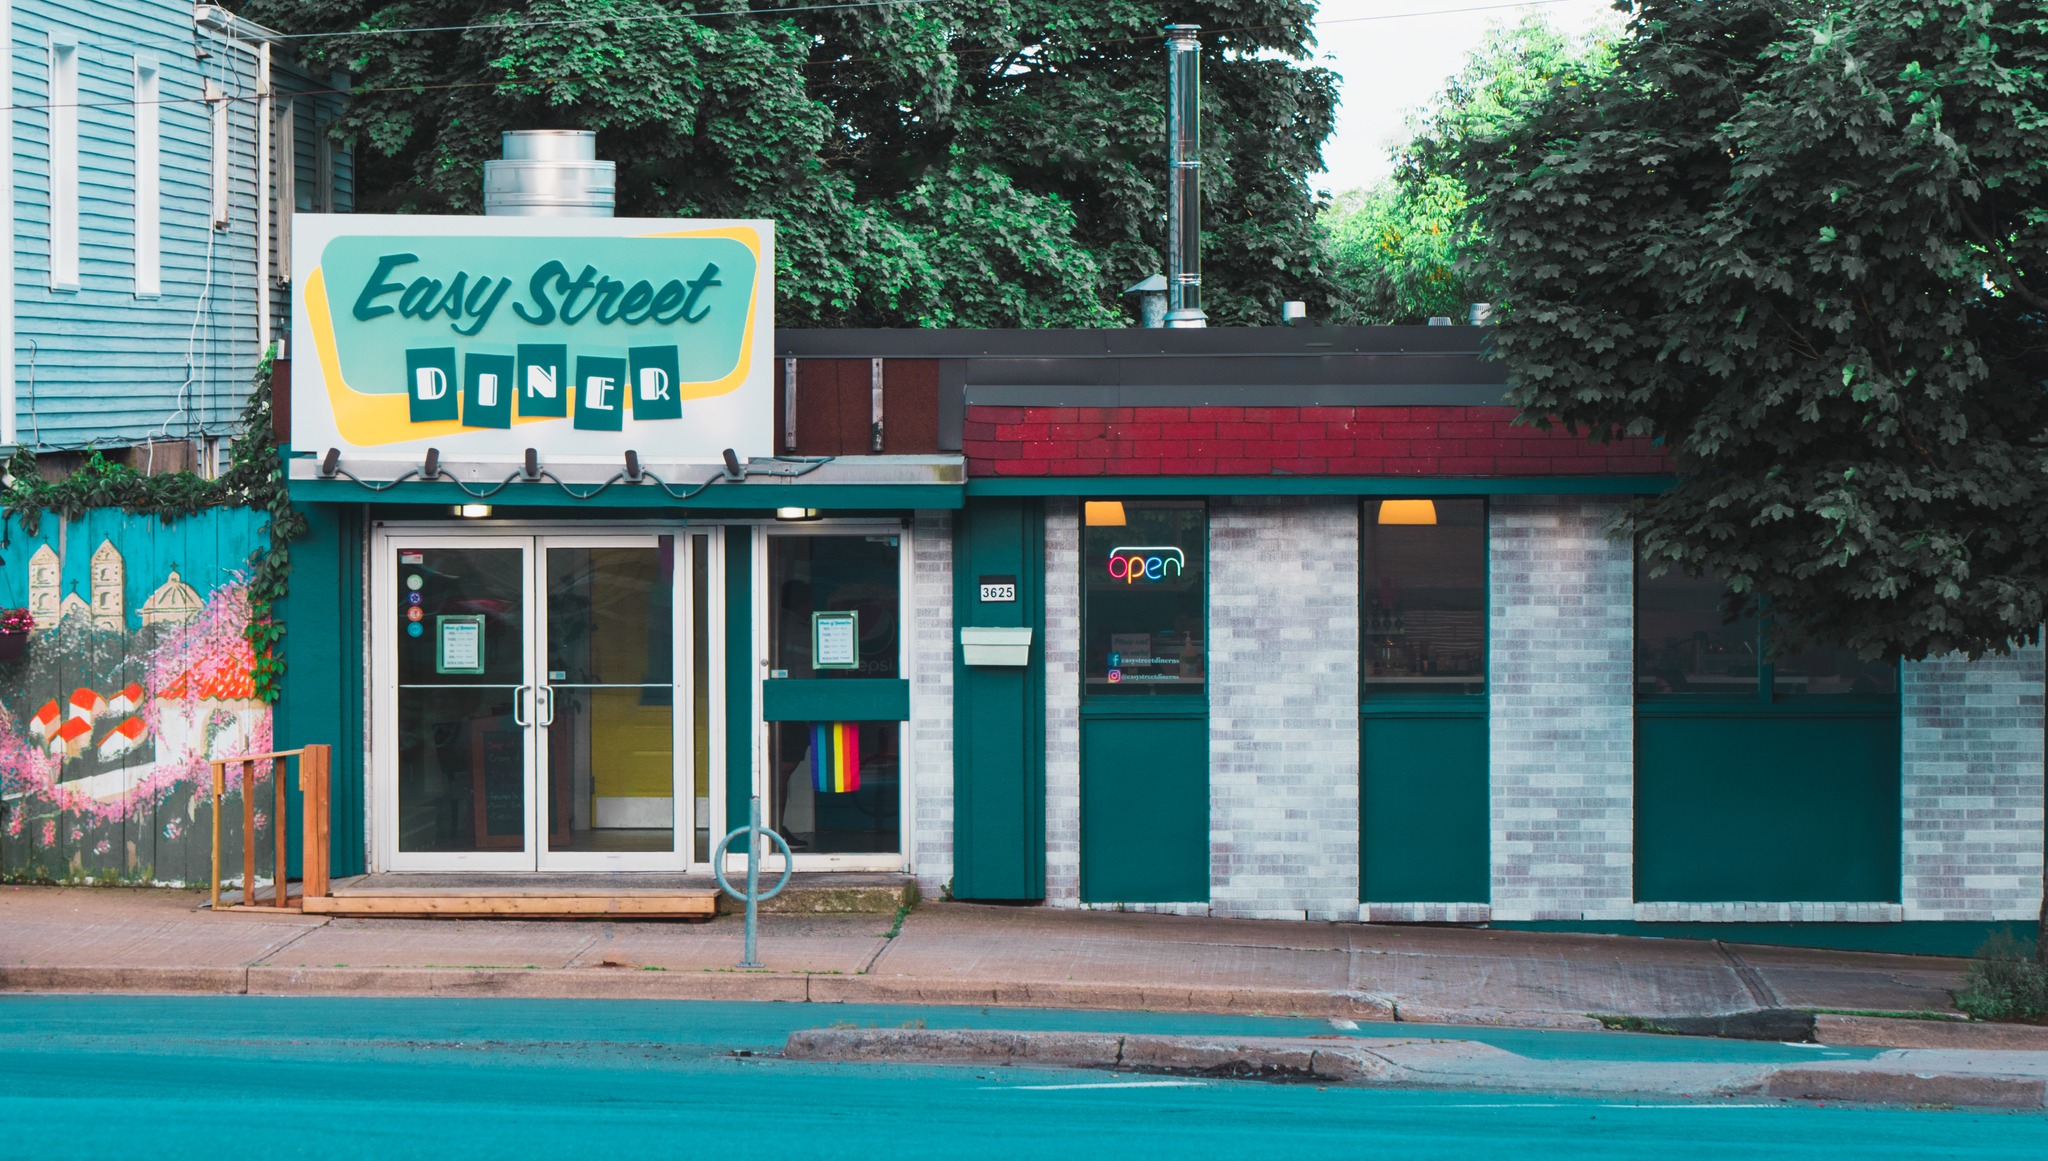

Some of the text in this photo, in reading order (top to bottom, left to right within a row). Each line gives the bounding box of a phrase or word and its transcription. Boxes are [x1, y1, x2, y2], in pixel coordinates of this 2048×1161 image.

[352, 253, 722, 336] Easy Street
[416, 365, 670, 410] DINER
[1109, 556, 1181, 584] open
[983, 587, 1013, 598] 3625
